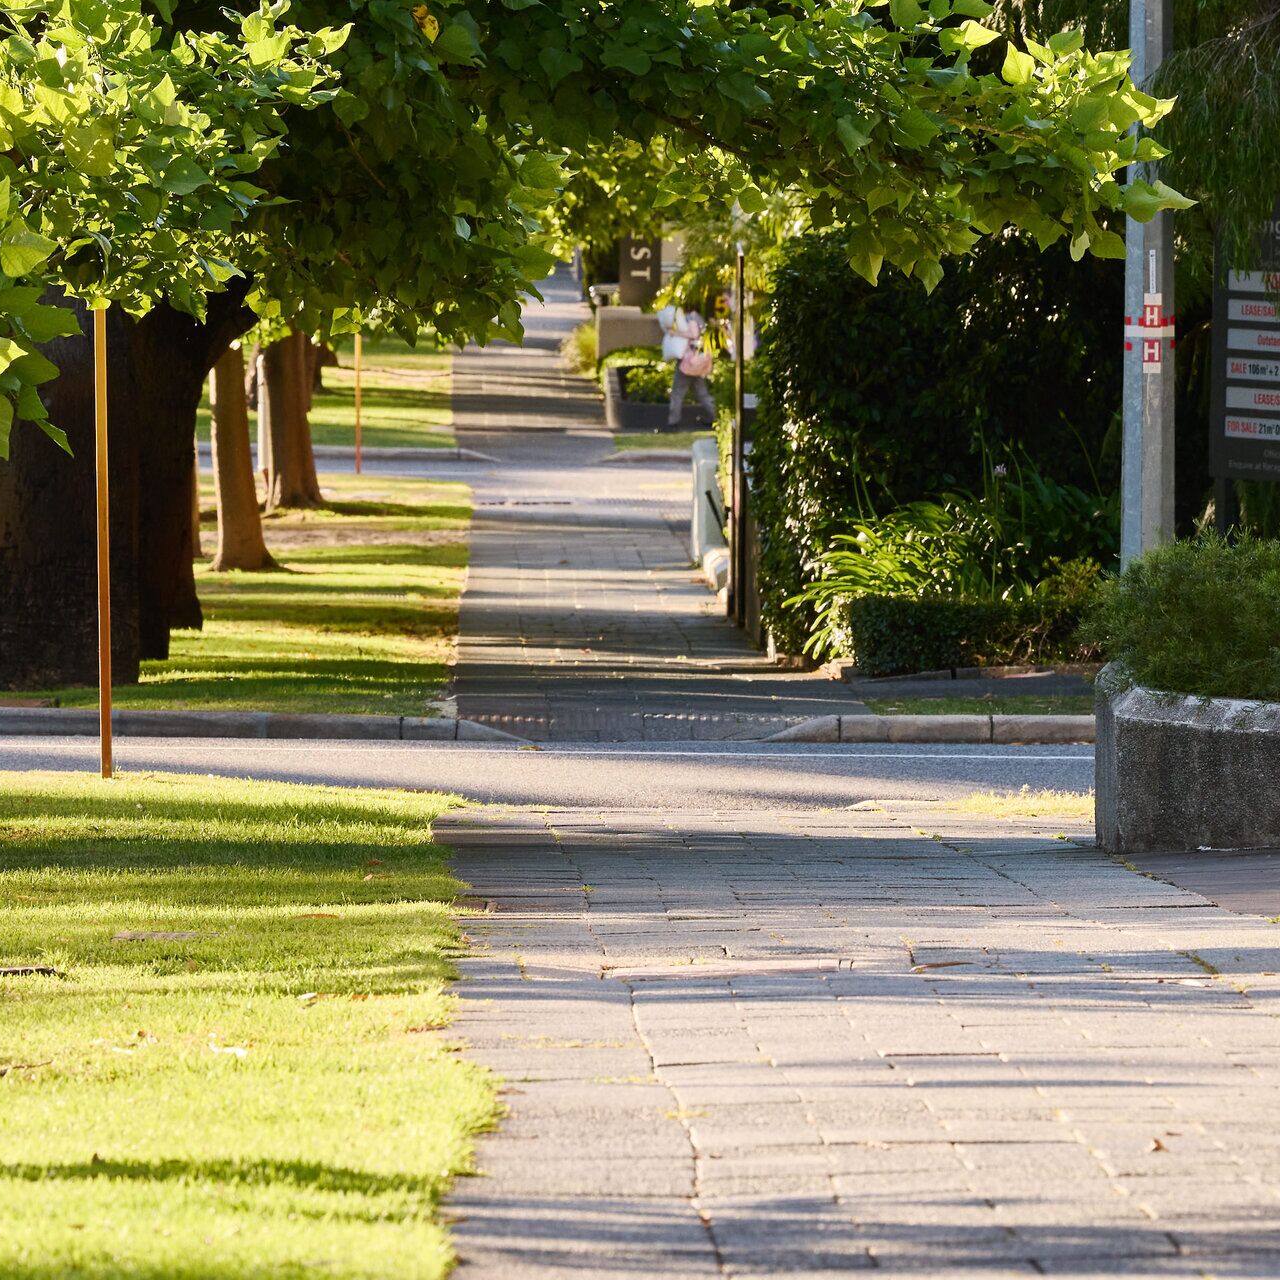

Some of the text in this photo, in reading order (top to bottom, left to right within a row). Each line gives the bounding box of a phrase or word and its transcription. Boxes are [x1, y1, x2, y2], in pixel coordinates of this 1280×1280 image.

[1146, 307, 1158, 326] H
[1241, 305, 1277, 317] LEASE/SAL
[1144, 342, 1158, 361] H
[1231, 363, 1247, 374] SALE
[1274, 366, 1279, 376] 2
[1227, 421, 1240, 432] FOR
[1241, 421, 1257, 433] SALE
